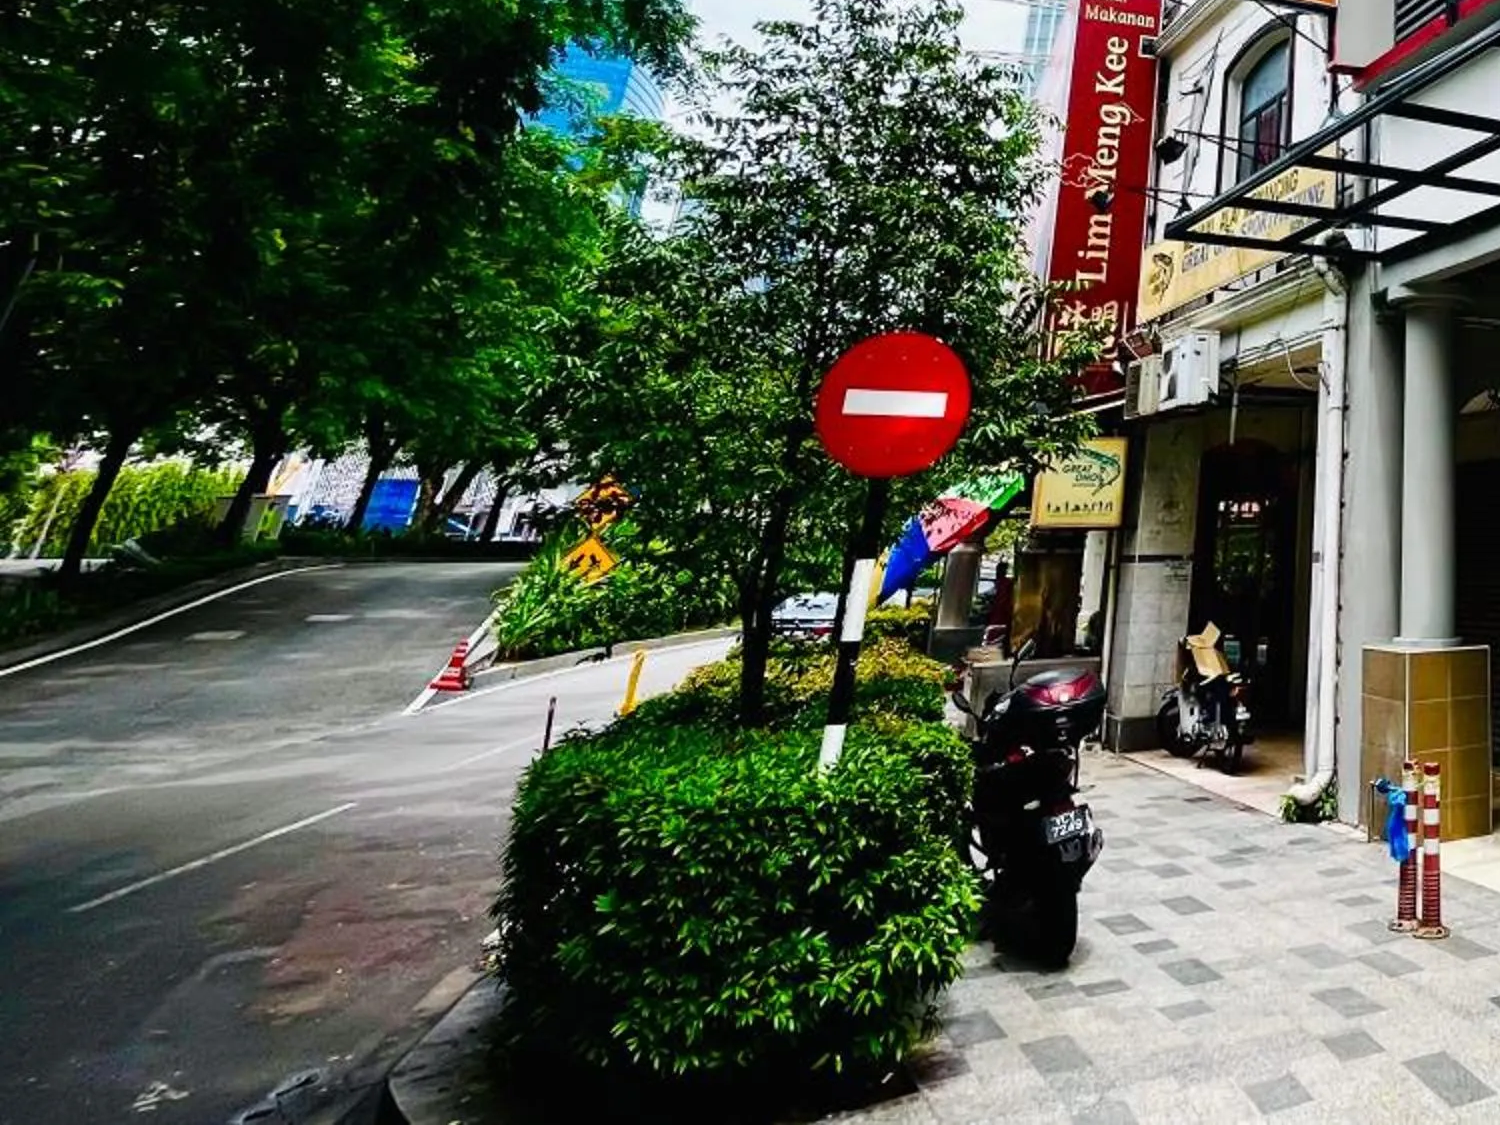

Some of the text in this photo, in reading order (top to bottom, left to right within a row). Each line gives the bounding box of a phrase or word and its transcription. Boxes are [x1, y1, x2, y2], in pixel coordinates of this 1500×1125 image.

[1085, 3, 1155, 28] Makanan
[1076, 35, 1132, 284] Lim Meng Kee
